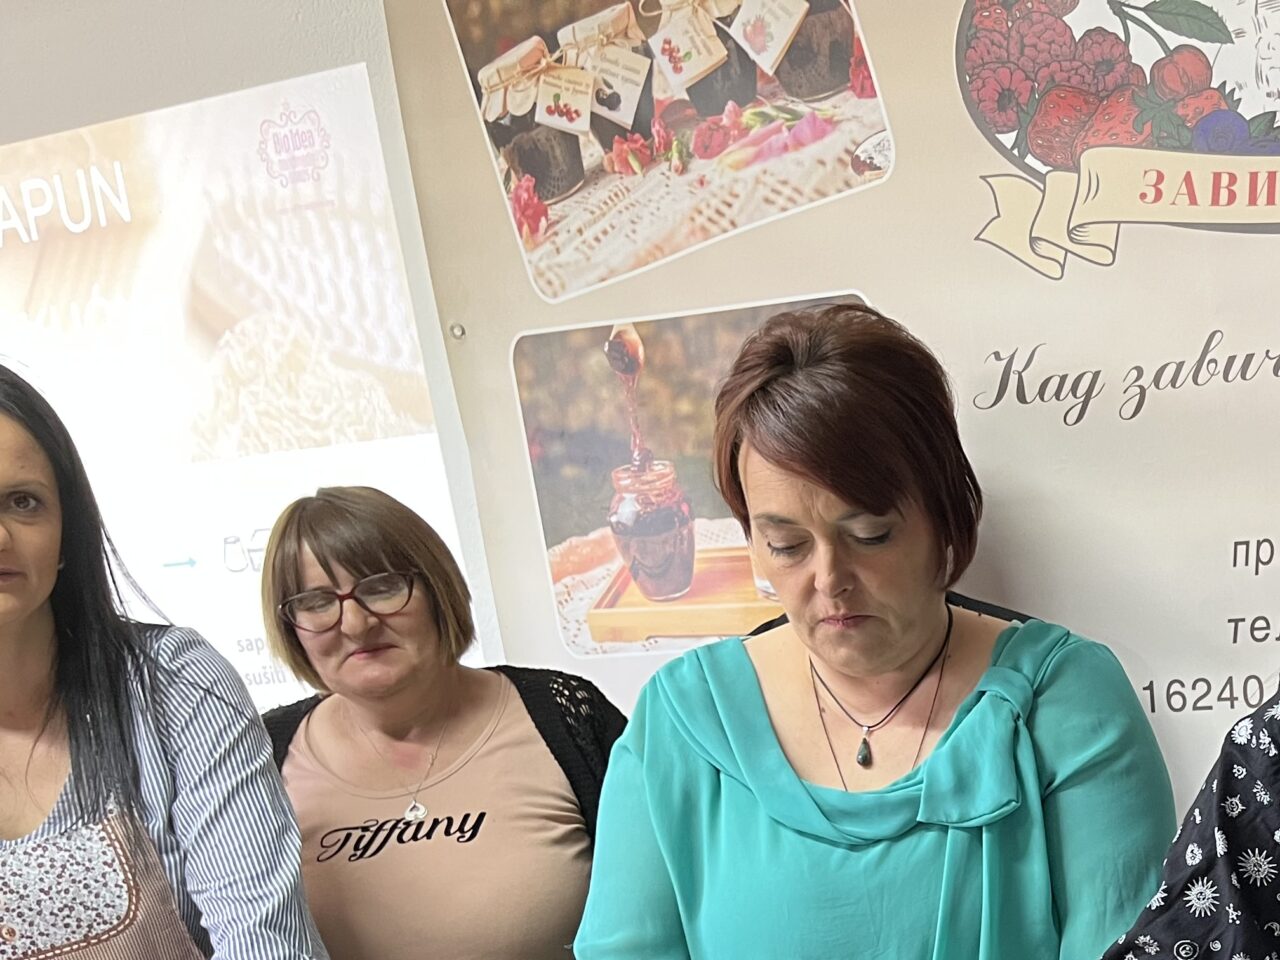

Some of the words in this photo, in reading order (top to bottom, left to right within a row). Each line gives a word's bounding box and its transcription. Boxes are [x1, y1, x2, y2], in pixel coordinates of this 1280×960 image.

[972, 342, 1105, 427] Кад
[236, 637, 265, 655] sap
[1142, 674, 1265, 714] 16240
[316, 811, 488, 863] Tiffany
